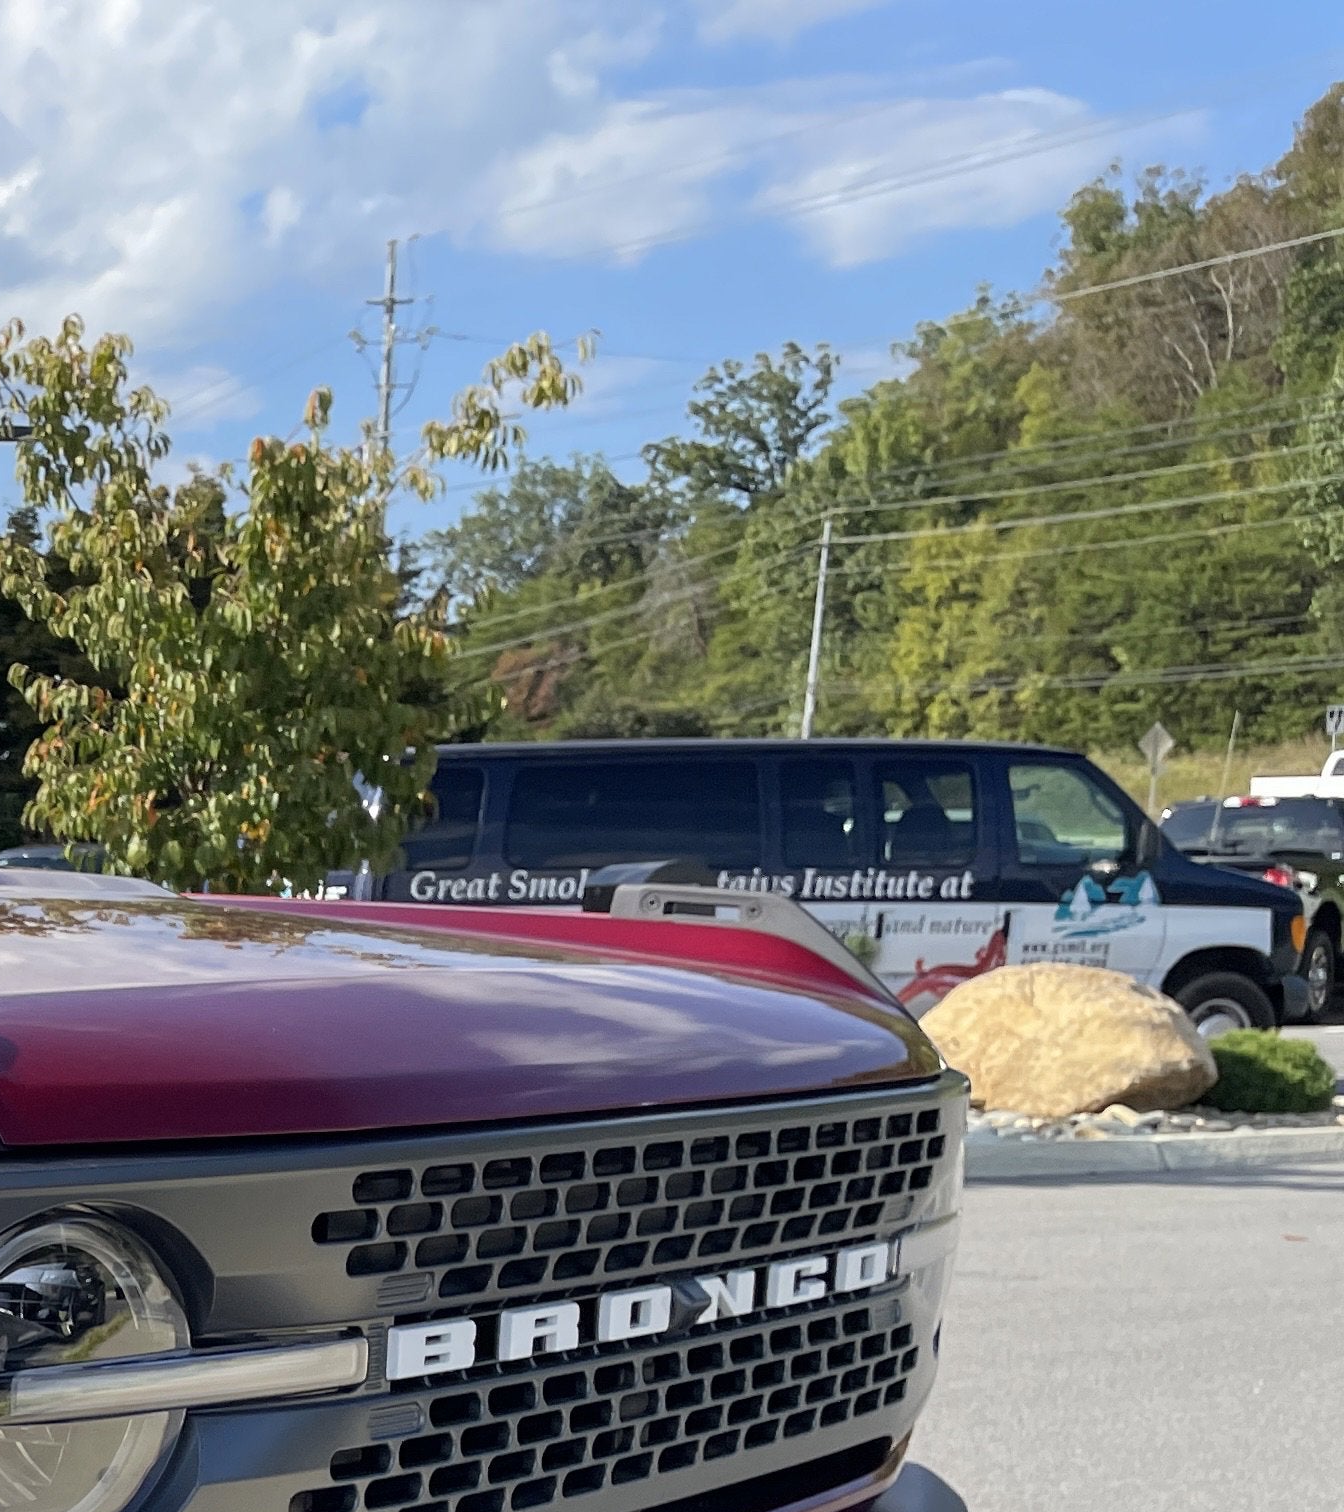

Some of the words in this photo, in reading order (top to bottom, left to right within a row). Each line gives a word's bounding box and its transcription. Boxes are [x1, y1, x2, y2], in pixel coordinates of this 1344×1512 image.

[411, 870, 502, 900] Great
[800, 867, 934, 899] Institute
[939, 869, 974, 899] at
[386, 1239, 889, 1381] BRONCO
